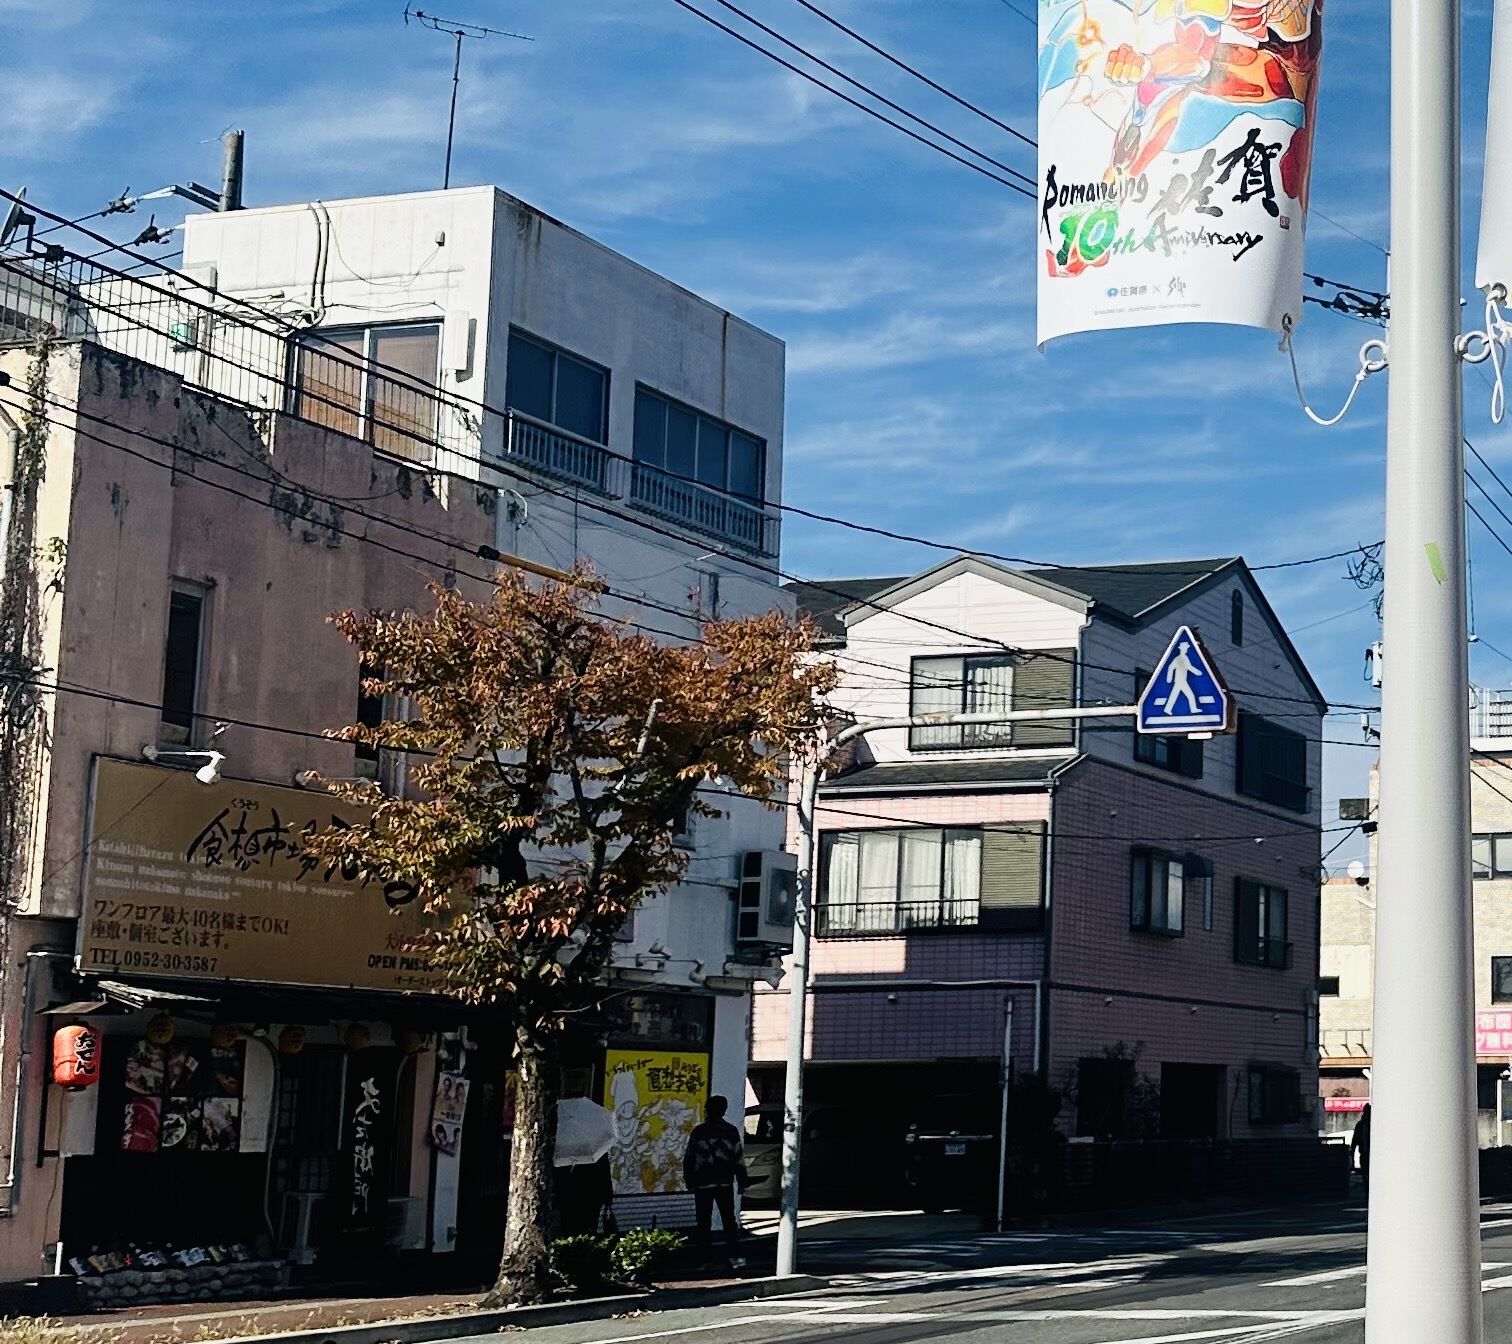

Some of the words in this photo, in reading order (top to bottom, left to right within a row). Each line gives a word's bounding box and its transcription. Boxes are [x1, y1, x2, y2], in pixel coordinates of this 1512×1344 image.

[90, 947, 122, 966] TEL
[124, 951, 217, 973] 0952-30-3587
[368, 954, 396, 969] OPEN
[74, 1032, 97, 1075] おでん
